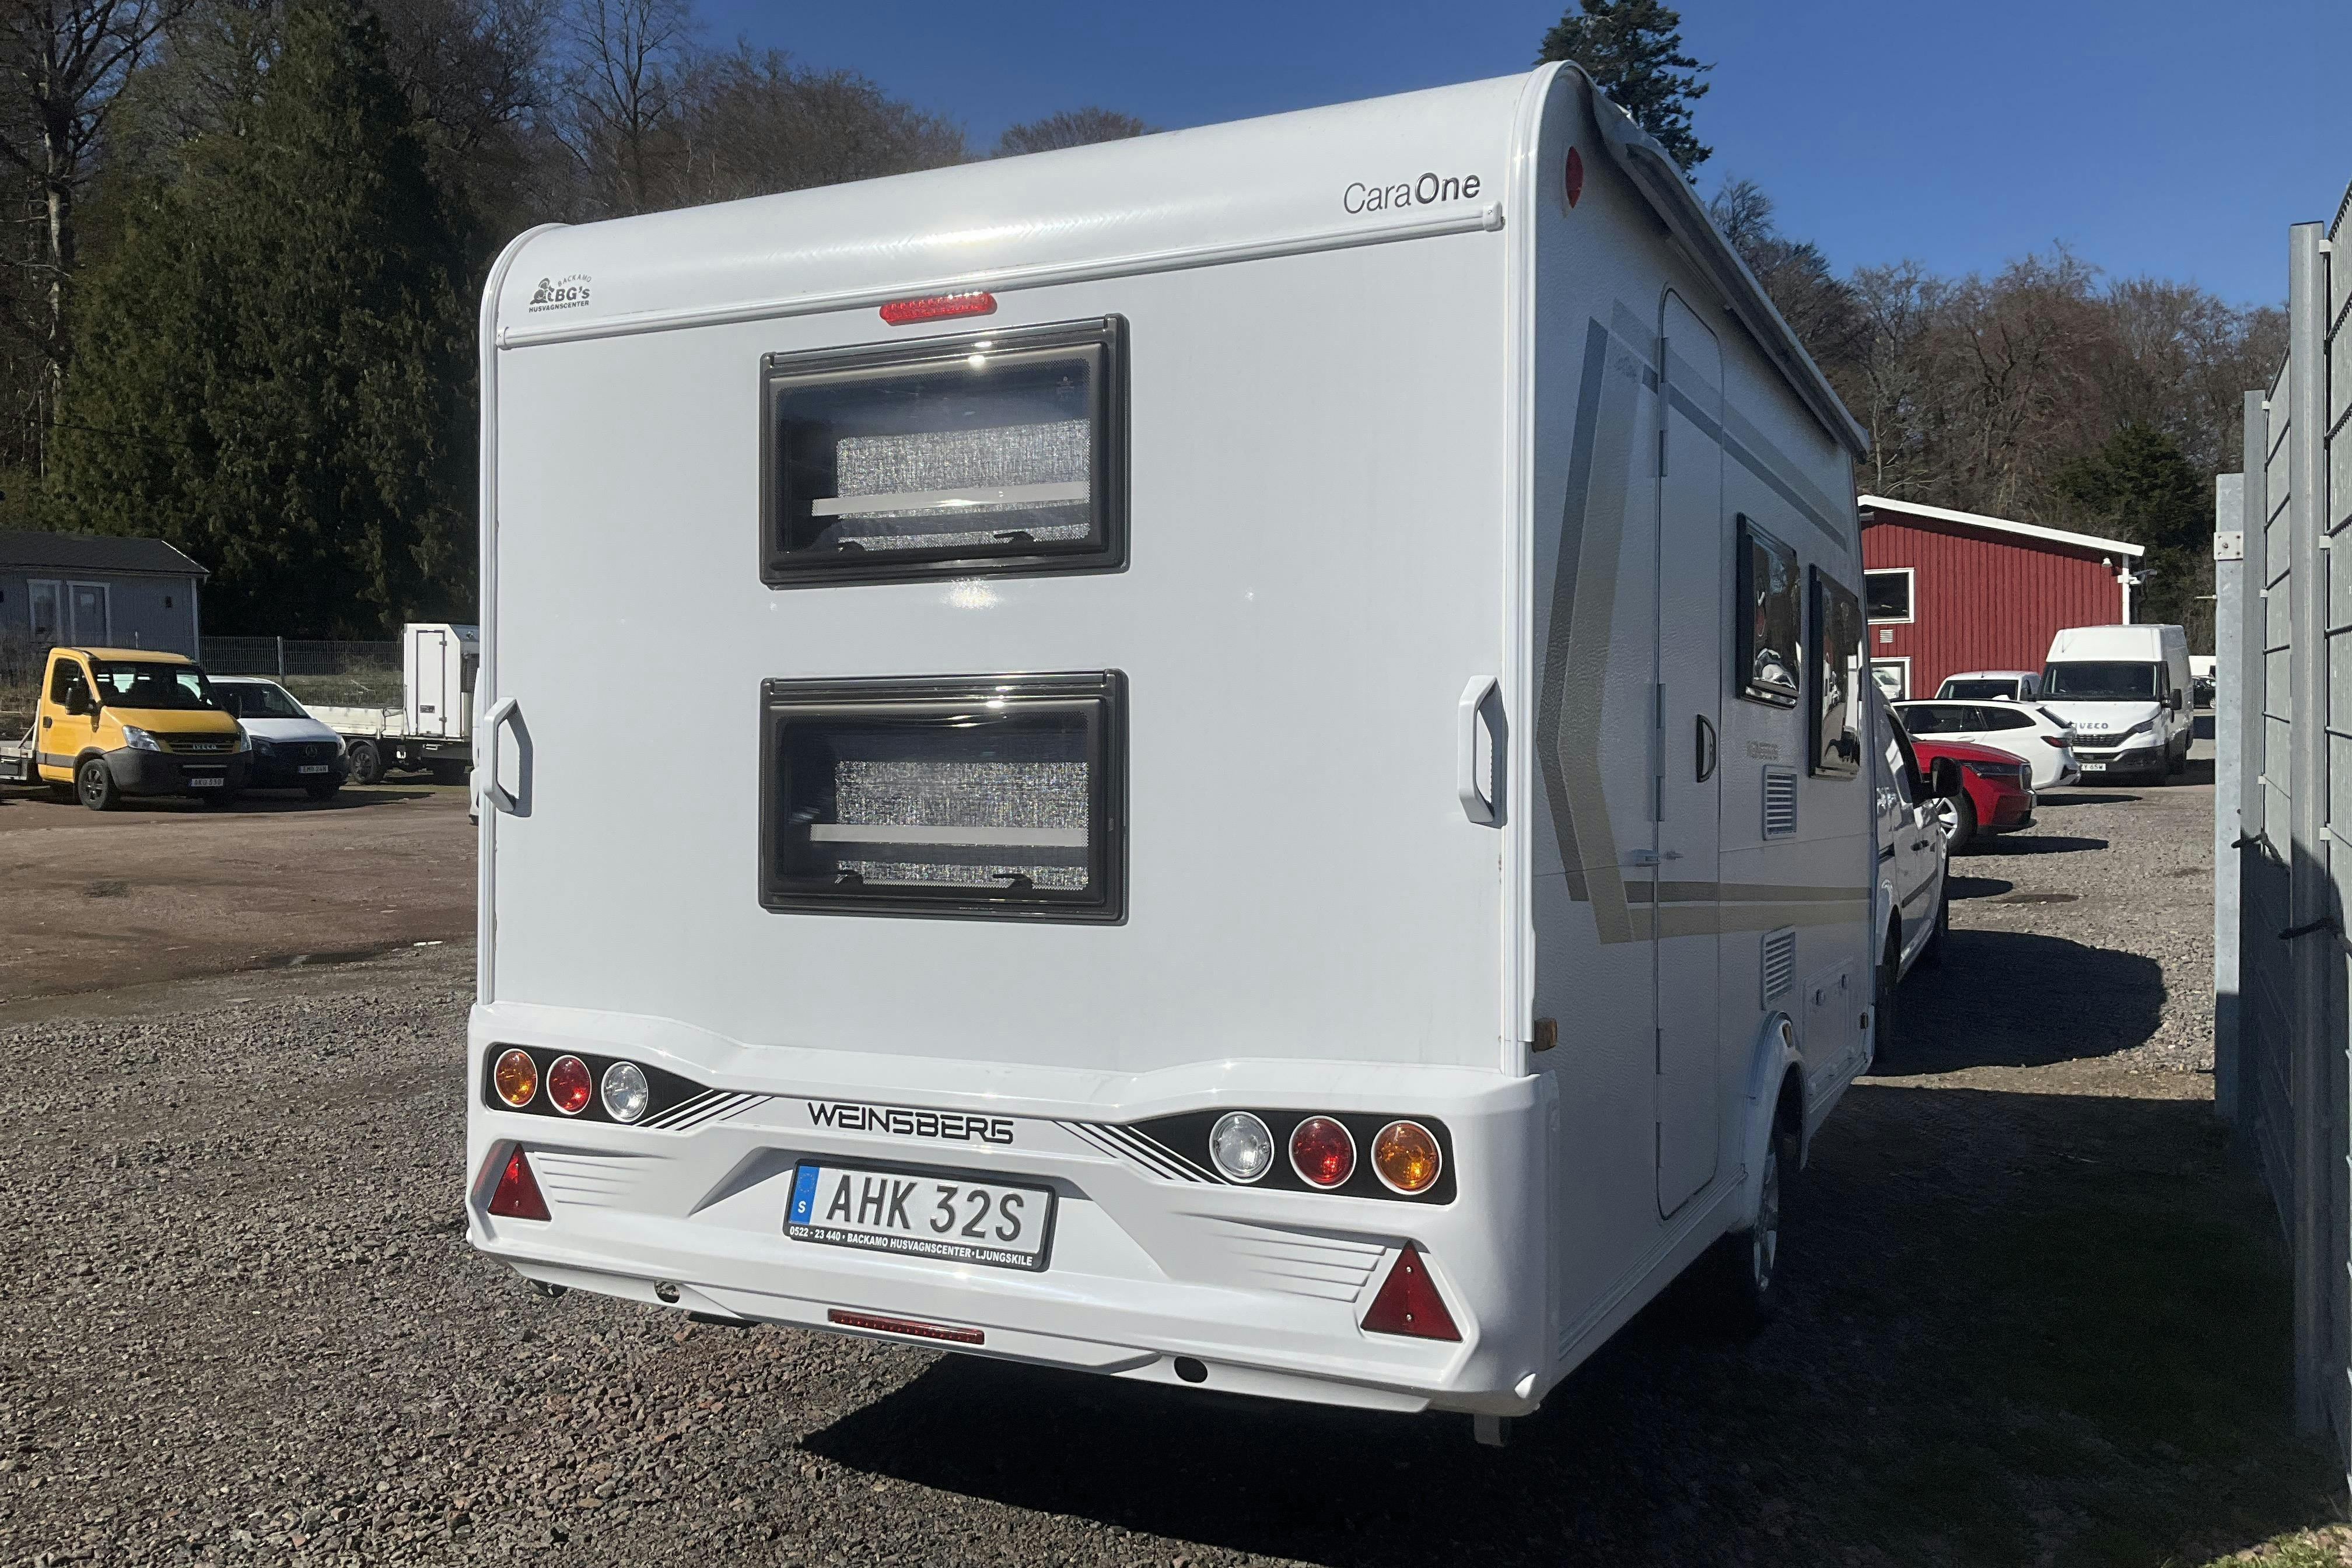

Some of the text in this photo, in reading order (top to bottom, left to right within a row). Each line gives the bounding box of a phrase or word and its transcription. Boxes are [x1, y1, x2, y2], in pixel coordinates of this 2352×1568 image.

[1343, 172, 1480, 215] CaraOne
[558, 274, 592, 287] BACKAMO
[528, 300, 589, 313] HUSVAGNSCENTER
[807, 1102, 1014, 1144] WEINSBERG
[797, 1200, 806, 1213] S
[826, 1174, 1025, 1241] AHK 32S
[790, 1226, 808, 1237] 0522
[814, 1229, 824, 1239] 23
[826, 1230, 841, 1241] 440
[847, 1233, 888, 1247] BACKAMO
[890, 1238, 971, 1258] HUSVAGNSCENTER
[975, 1249, 1032, 1266] LJUNGSKILE
